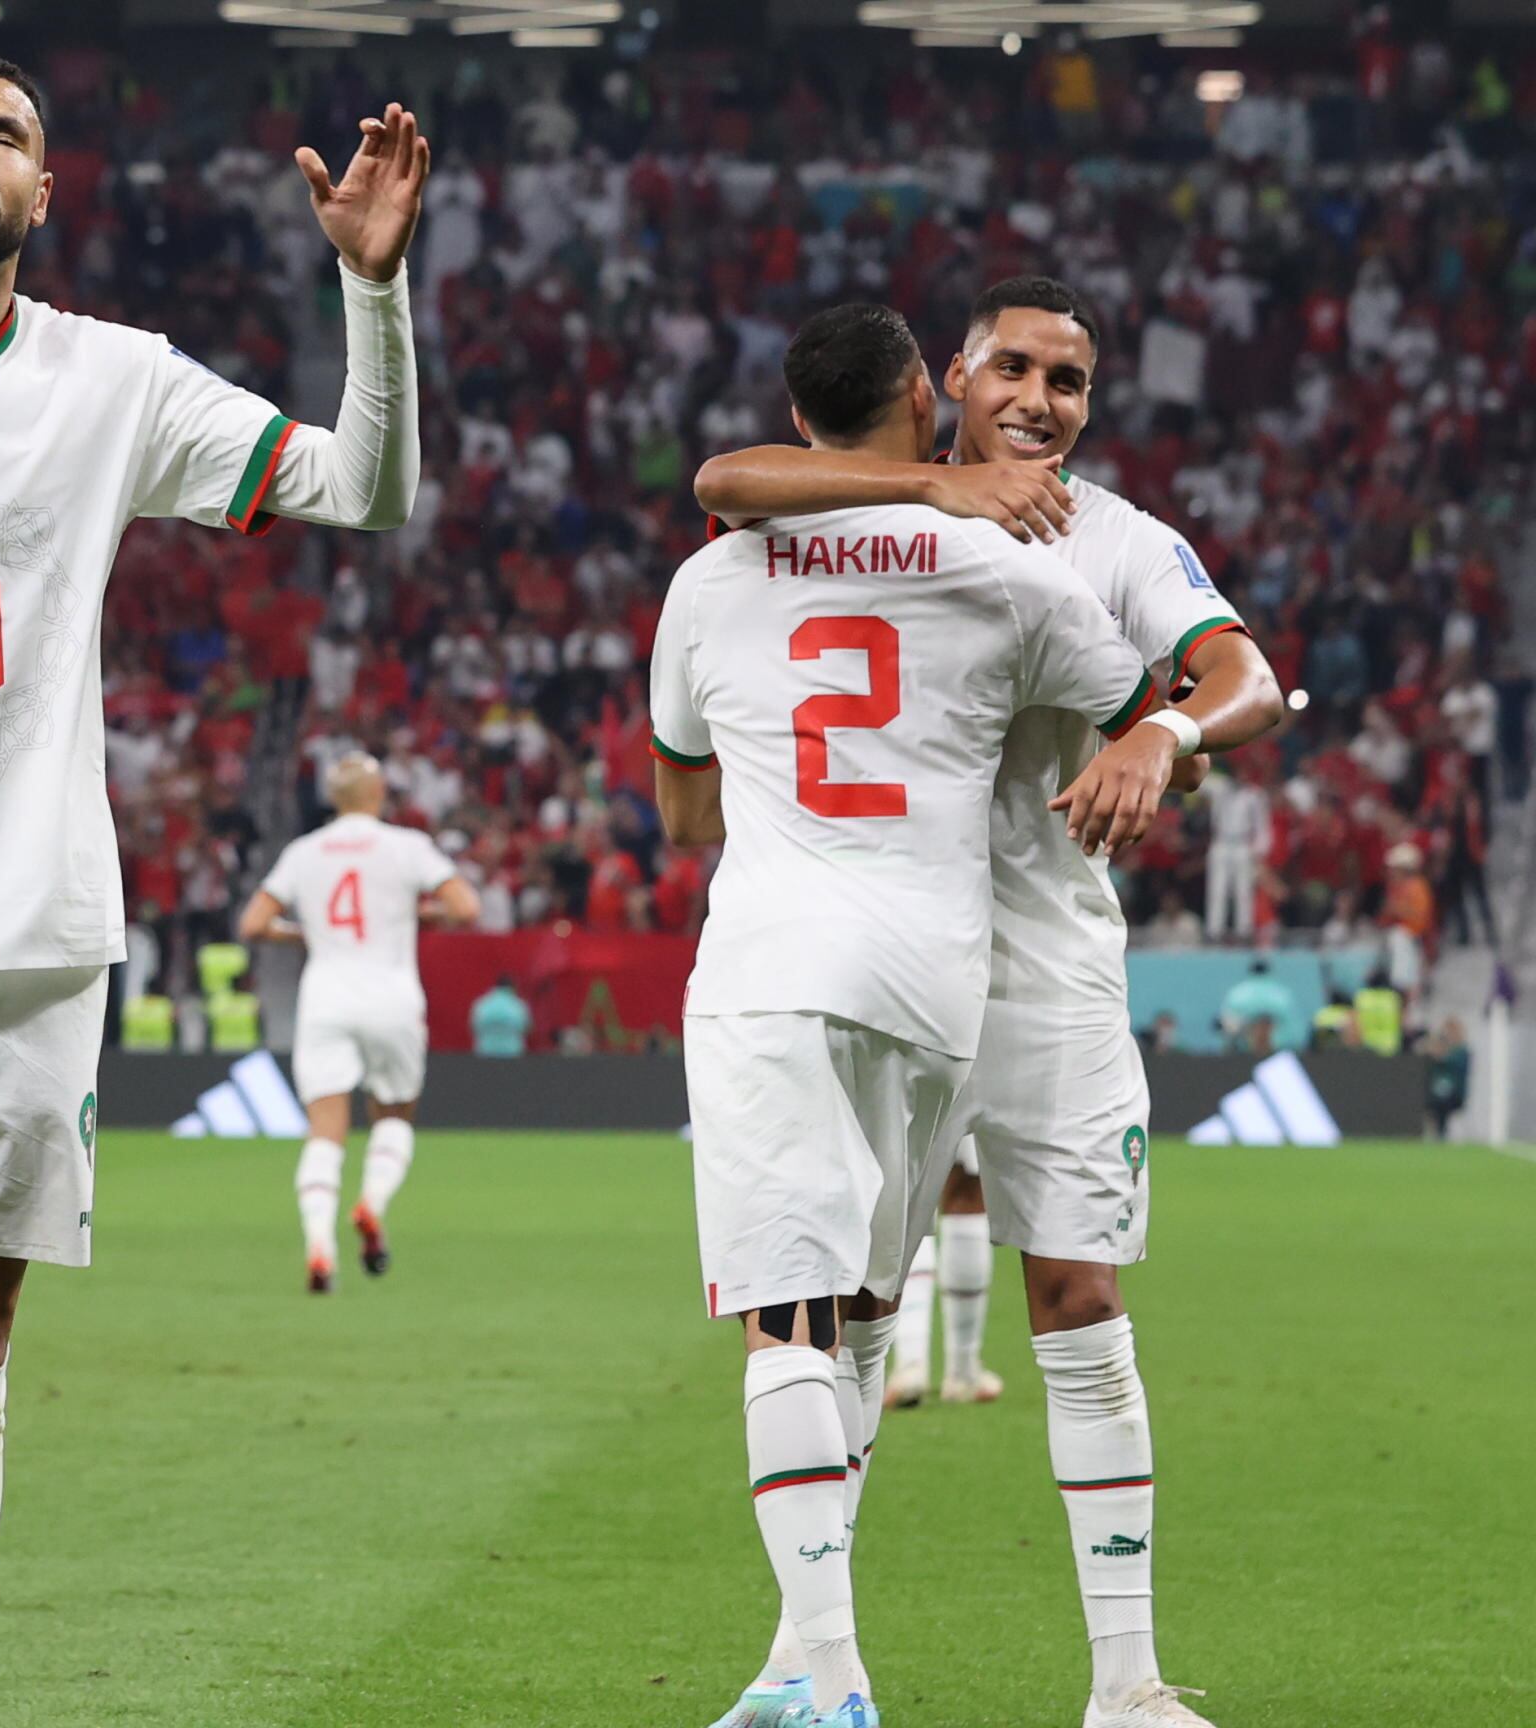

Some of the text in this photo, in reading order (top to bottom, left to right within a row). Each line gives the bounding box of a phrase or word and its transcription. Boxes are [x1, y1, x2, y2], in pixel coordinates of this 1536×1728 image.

[766, 533, 937, 578] HAKIMI
[789, 616, 907, 817] 2
[327, 868, 366, 944] 4
[1091, 1545, 1141, 1557] PUMA
